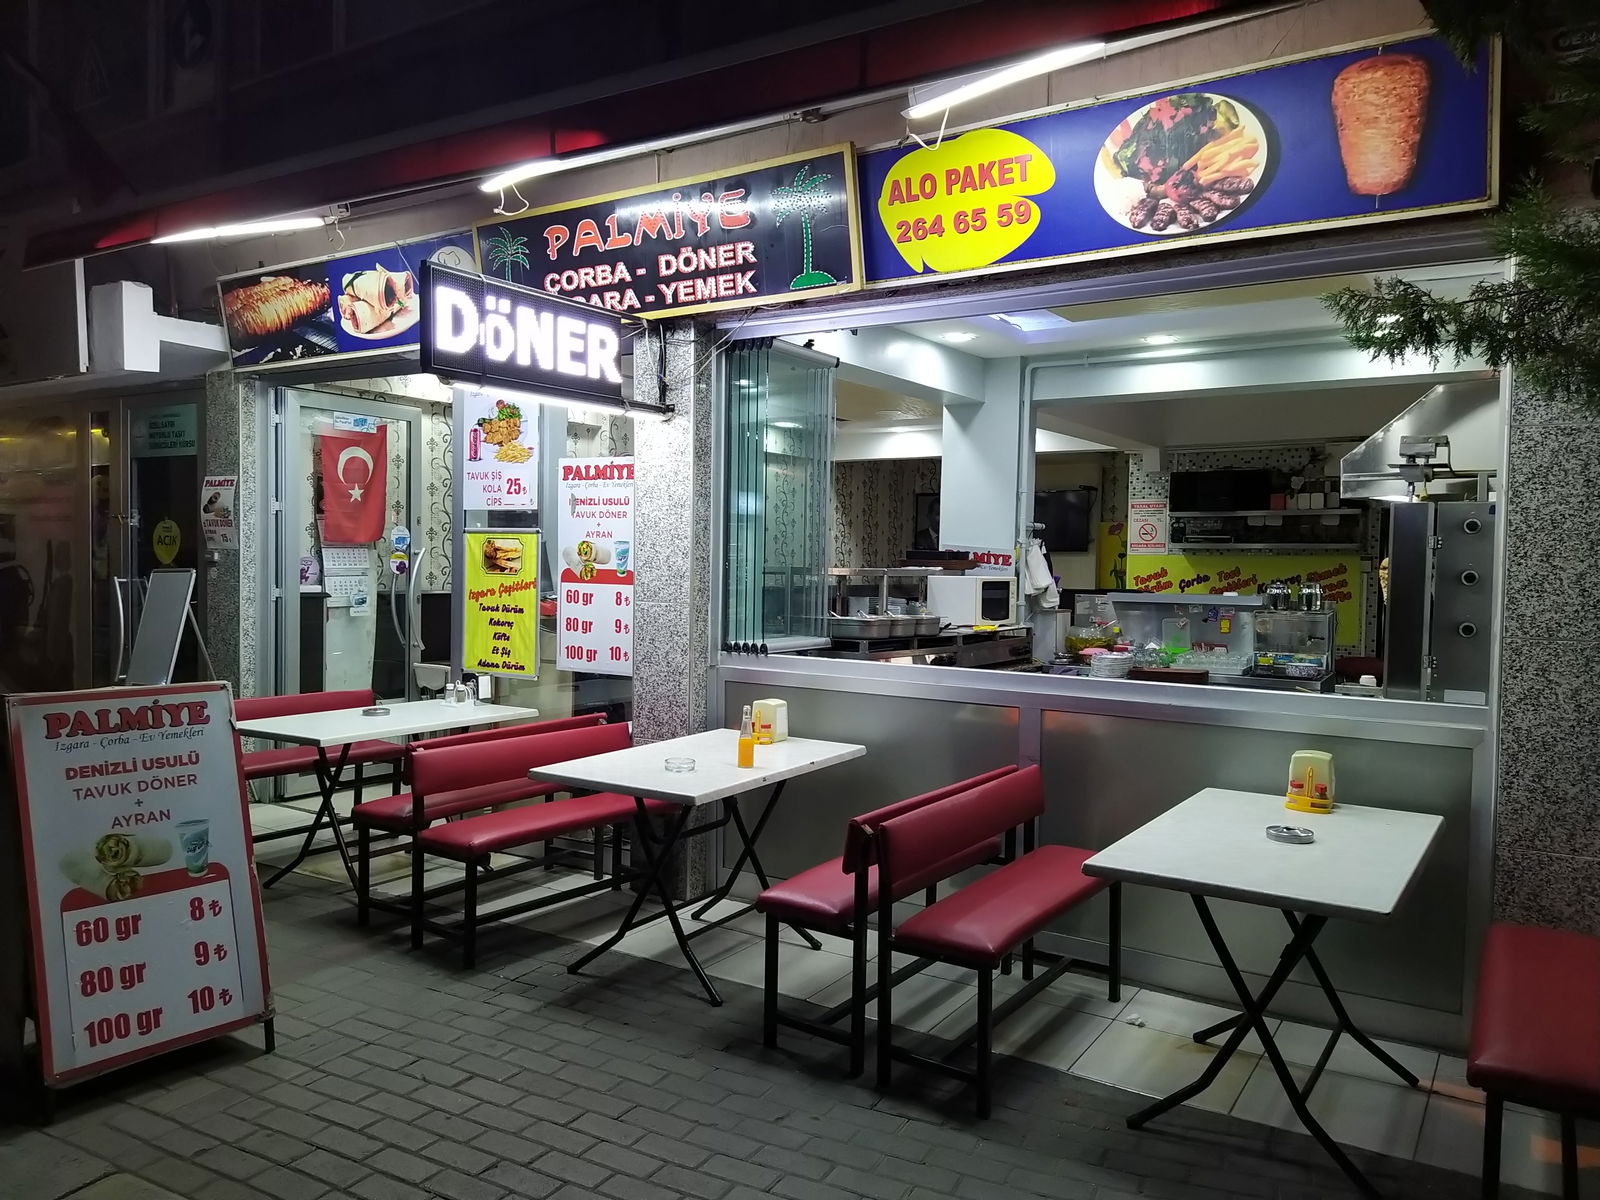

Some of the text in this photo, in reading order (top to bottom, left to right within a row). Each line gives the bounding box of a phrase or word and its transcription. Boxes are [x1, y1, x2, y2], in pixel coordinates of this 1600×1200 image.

[888, 154, 1032, 206] ALO PAKET
[543, 188, 751, 260] PALMİYE
[896, 200, 1031, 243] 264 65 59
[658, 241, 758, 278] DÖNER
[657, 270, 758, 305] YEMEK
[434, 286, 623, 384] DÖNER
[467, 472, 489, 480] TAVUK
[562, 461, 634, 481] PALMİYE
[483, 484, 502, 493] KOLA
[506, 478, 521, 495] 25
[602, 495, 630, 506] USULÜ
[599, 509, 628, 519] DÖNER
[469, 589, 496, 603] Izgara
[566, 589, 579, 603] 60
[582, 592, 593, 606] gr
[615, 591, 622, 606] 8
[479, 603, 524, 614] Tavuk Dürüm
[489, 617, 514, 629] Kokoreç
[565, 617, 578, 632] 80
[582, 620, 593, 634] gr
[615, 618, 622, 633] 9
[493, 632, 510, 641] Köfte
[492, 646, 511, 658] Et Şiş
[565, 645, 583, 660] 100
[586, 648, 597, 662] gr
[609, 646, 621, 661] 10
[477, 659, 525, 671] Adana Dürüm
[43, 699, 211, 740] PALMİYE
[55, 741, 90, 753] Izgara
[100, 736, 130, 749] Çorba
[140, 733, 156, 742] Ev
[157, 727, 204, 741] Yemekleri
[65, 750, 200, 780] DENİZLİ USULÜ
[73, 774, 198, 801] TAVUK DÖNER
[134, 799, 143, 807] +
[111, 809, 171, 829] AYRAN
[76, 917, 109, 946] 60
[116, 913, 141, 941] gr
[189, 897, 204, 921] 8
[80, 966, 114, 997] 80
[120, 962, 146, 990] gr
[194, 941, 209, 966] 9
[84, 1013, 131, 1047] 100
[137, 1007, 163, 1036] gr
[188, 986, 214, 1014] 10
